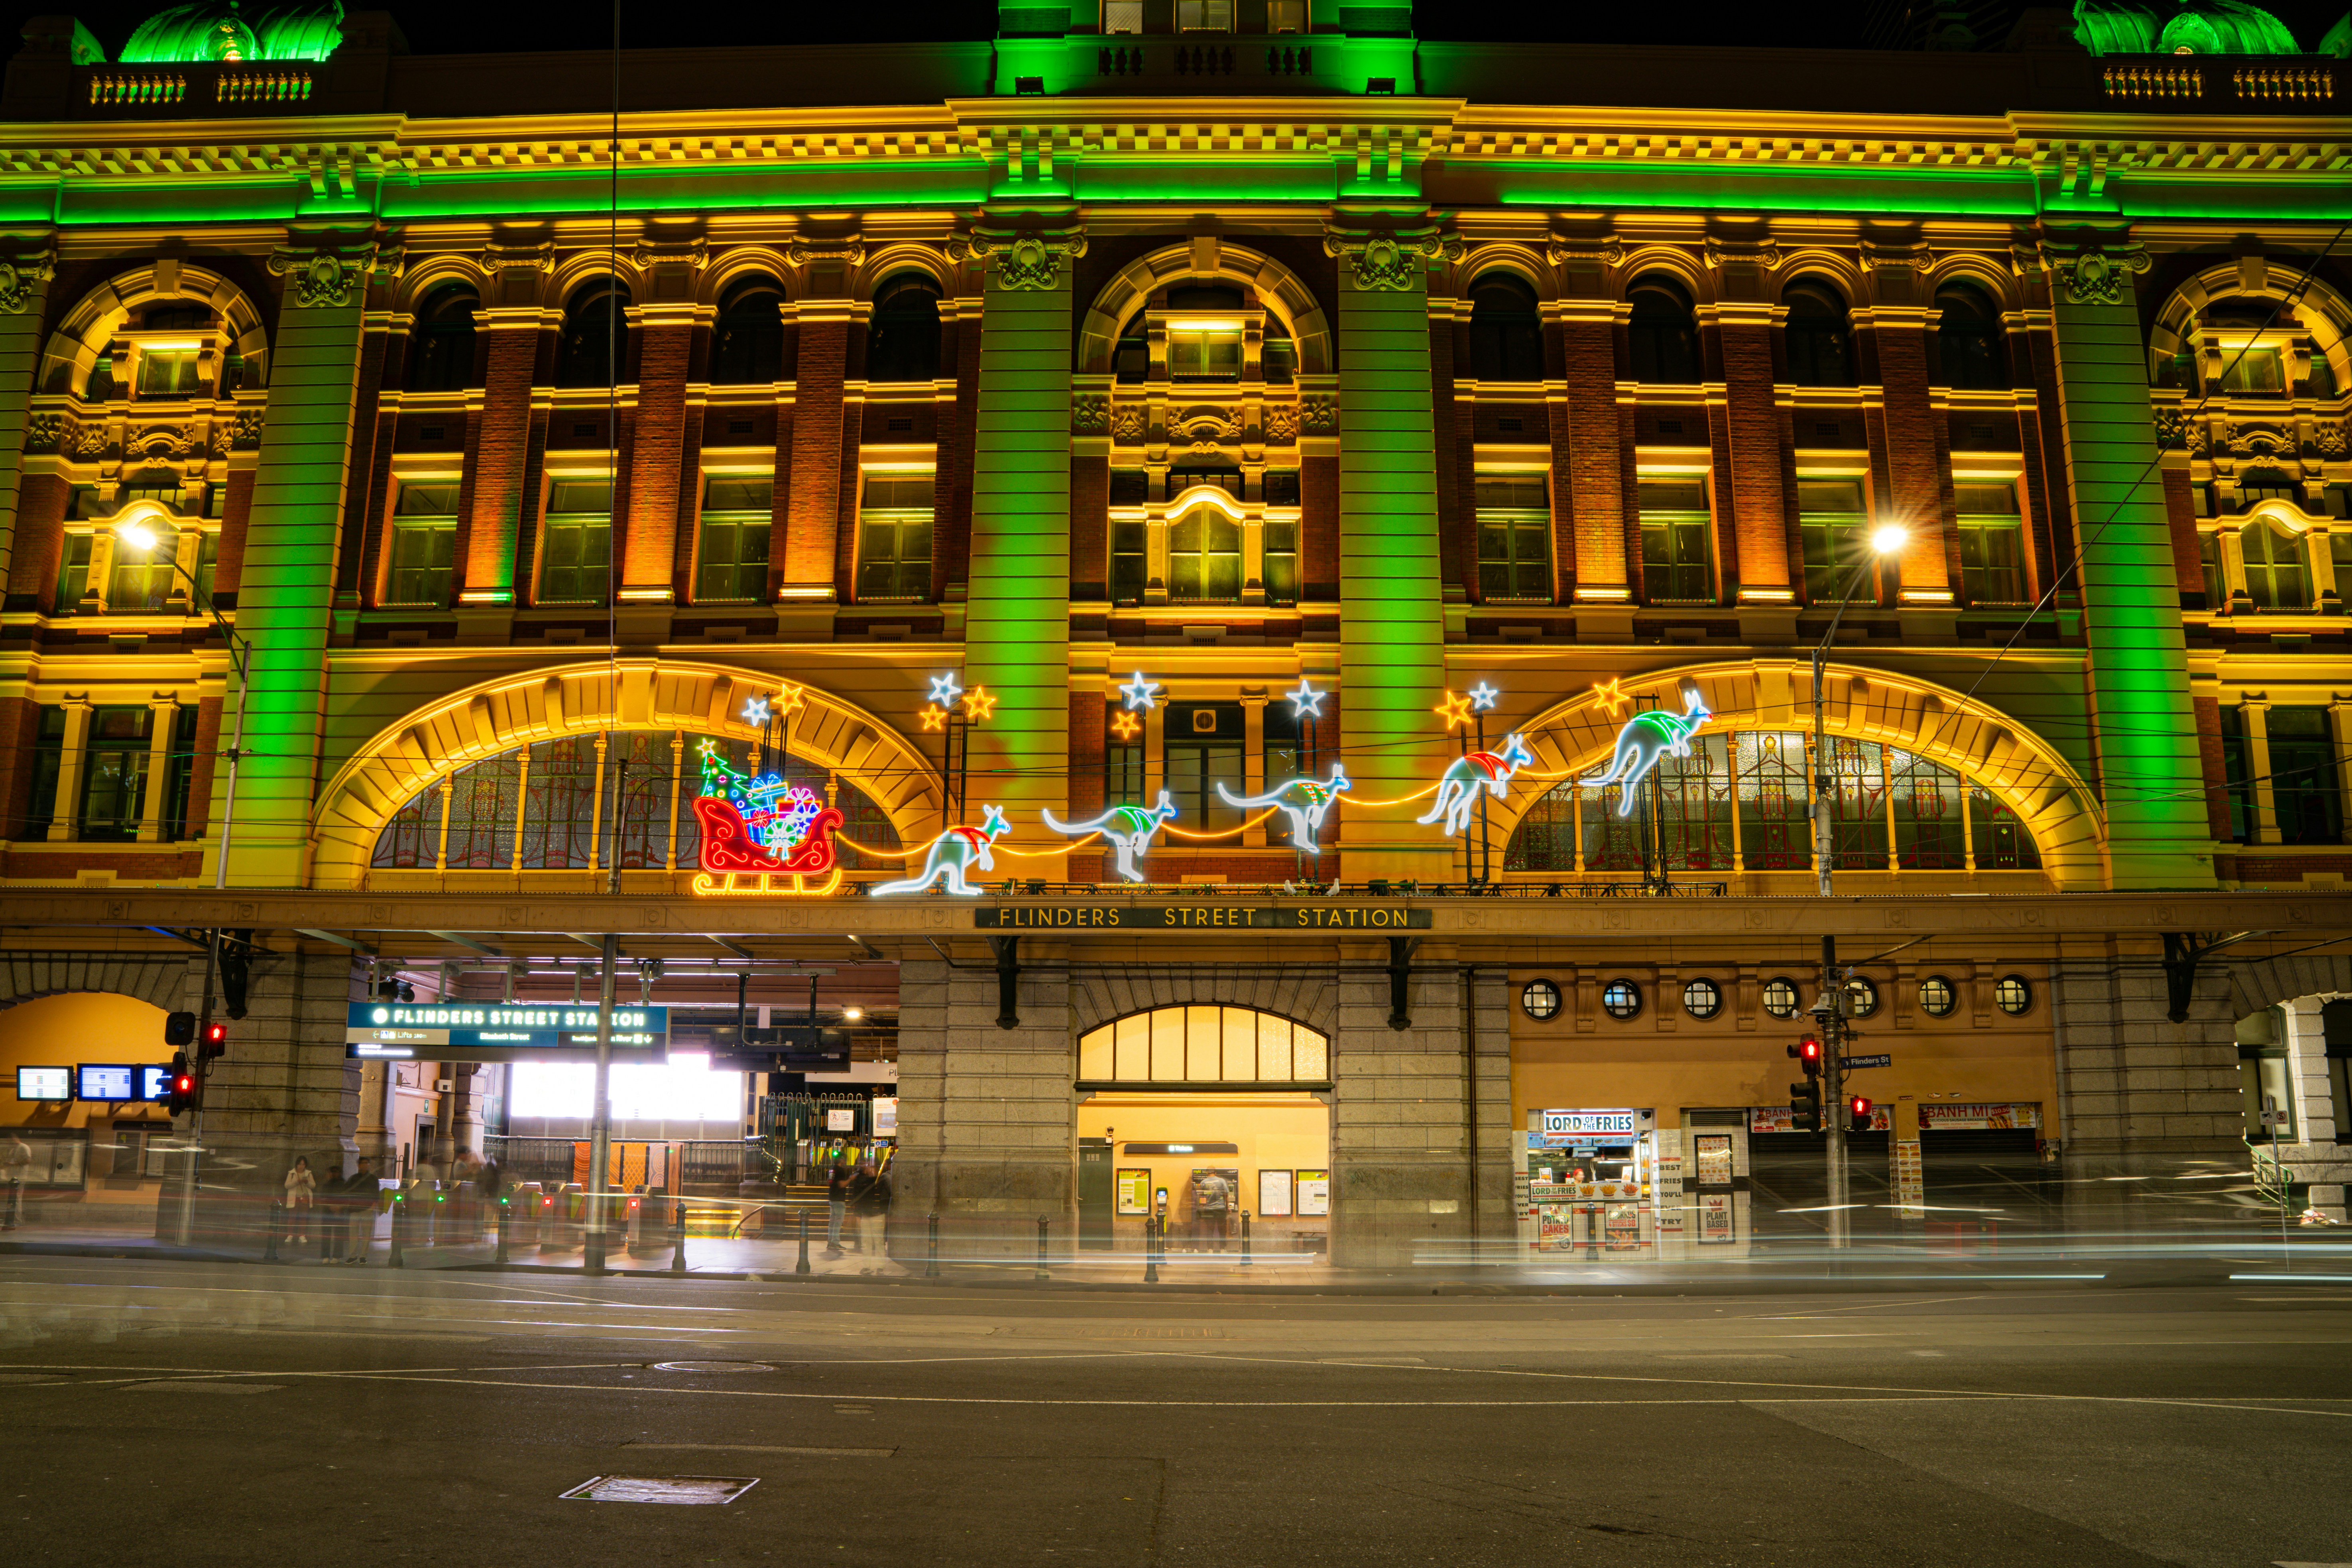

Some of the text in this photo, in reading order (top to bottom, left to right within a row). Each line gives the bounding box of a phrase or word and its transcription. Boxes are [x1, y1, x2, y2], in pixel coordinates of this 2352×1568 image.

[1000, 908, 1408, 926] FLINDERS STREET STATION
[394, 1010, 644, 1026] FLINDERS STREET STAION
[1927, 1105, 1988, 1117] BANH MI
[1546, 1117, 1582, 1131] LORD
[1596, 1116, 1632, 1130] FRIES
[1542, 1215, 1569, 1224] POTAO
[1608, 1210, 1636, 1219] CRROS
[1542, 1224, 1569, 1234] CAKES
